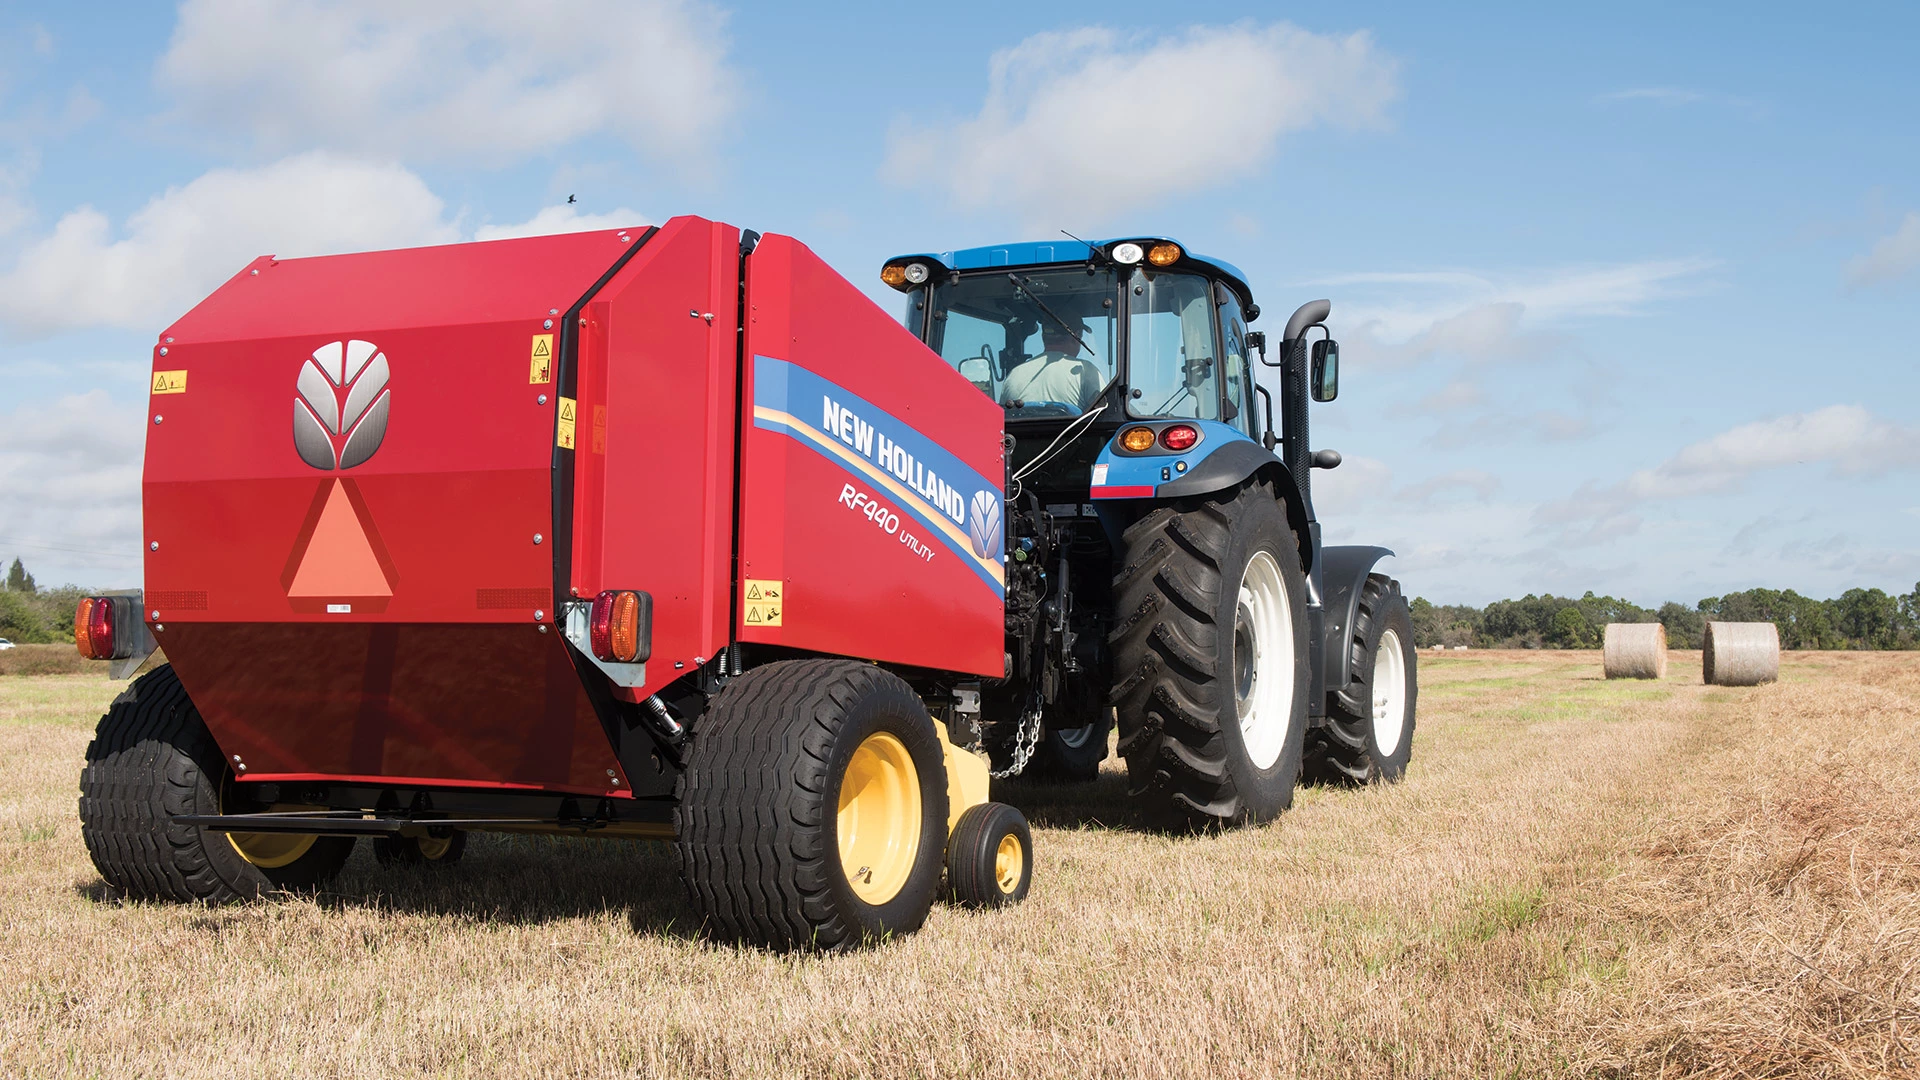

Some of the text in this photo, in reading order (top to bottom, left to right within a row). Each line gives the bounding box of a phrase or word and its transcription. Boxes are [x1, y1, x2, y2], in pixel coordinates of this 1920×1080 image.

[823, 395, 965, 525] NEW HOLLAND
[838, 483, 935, 562] RF440 UTILITY
